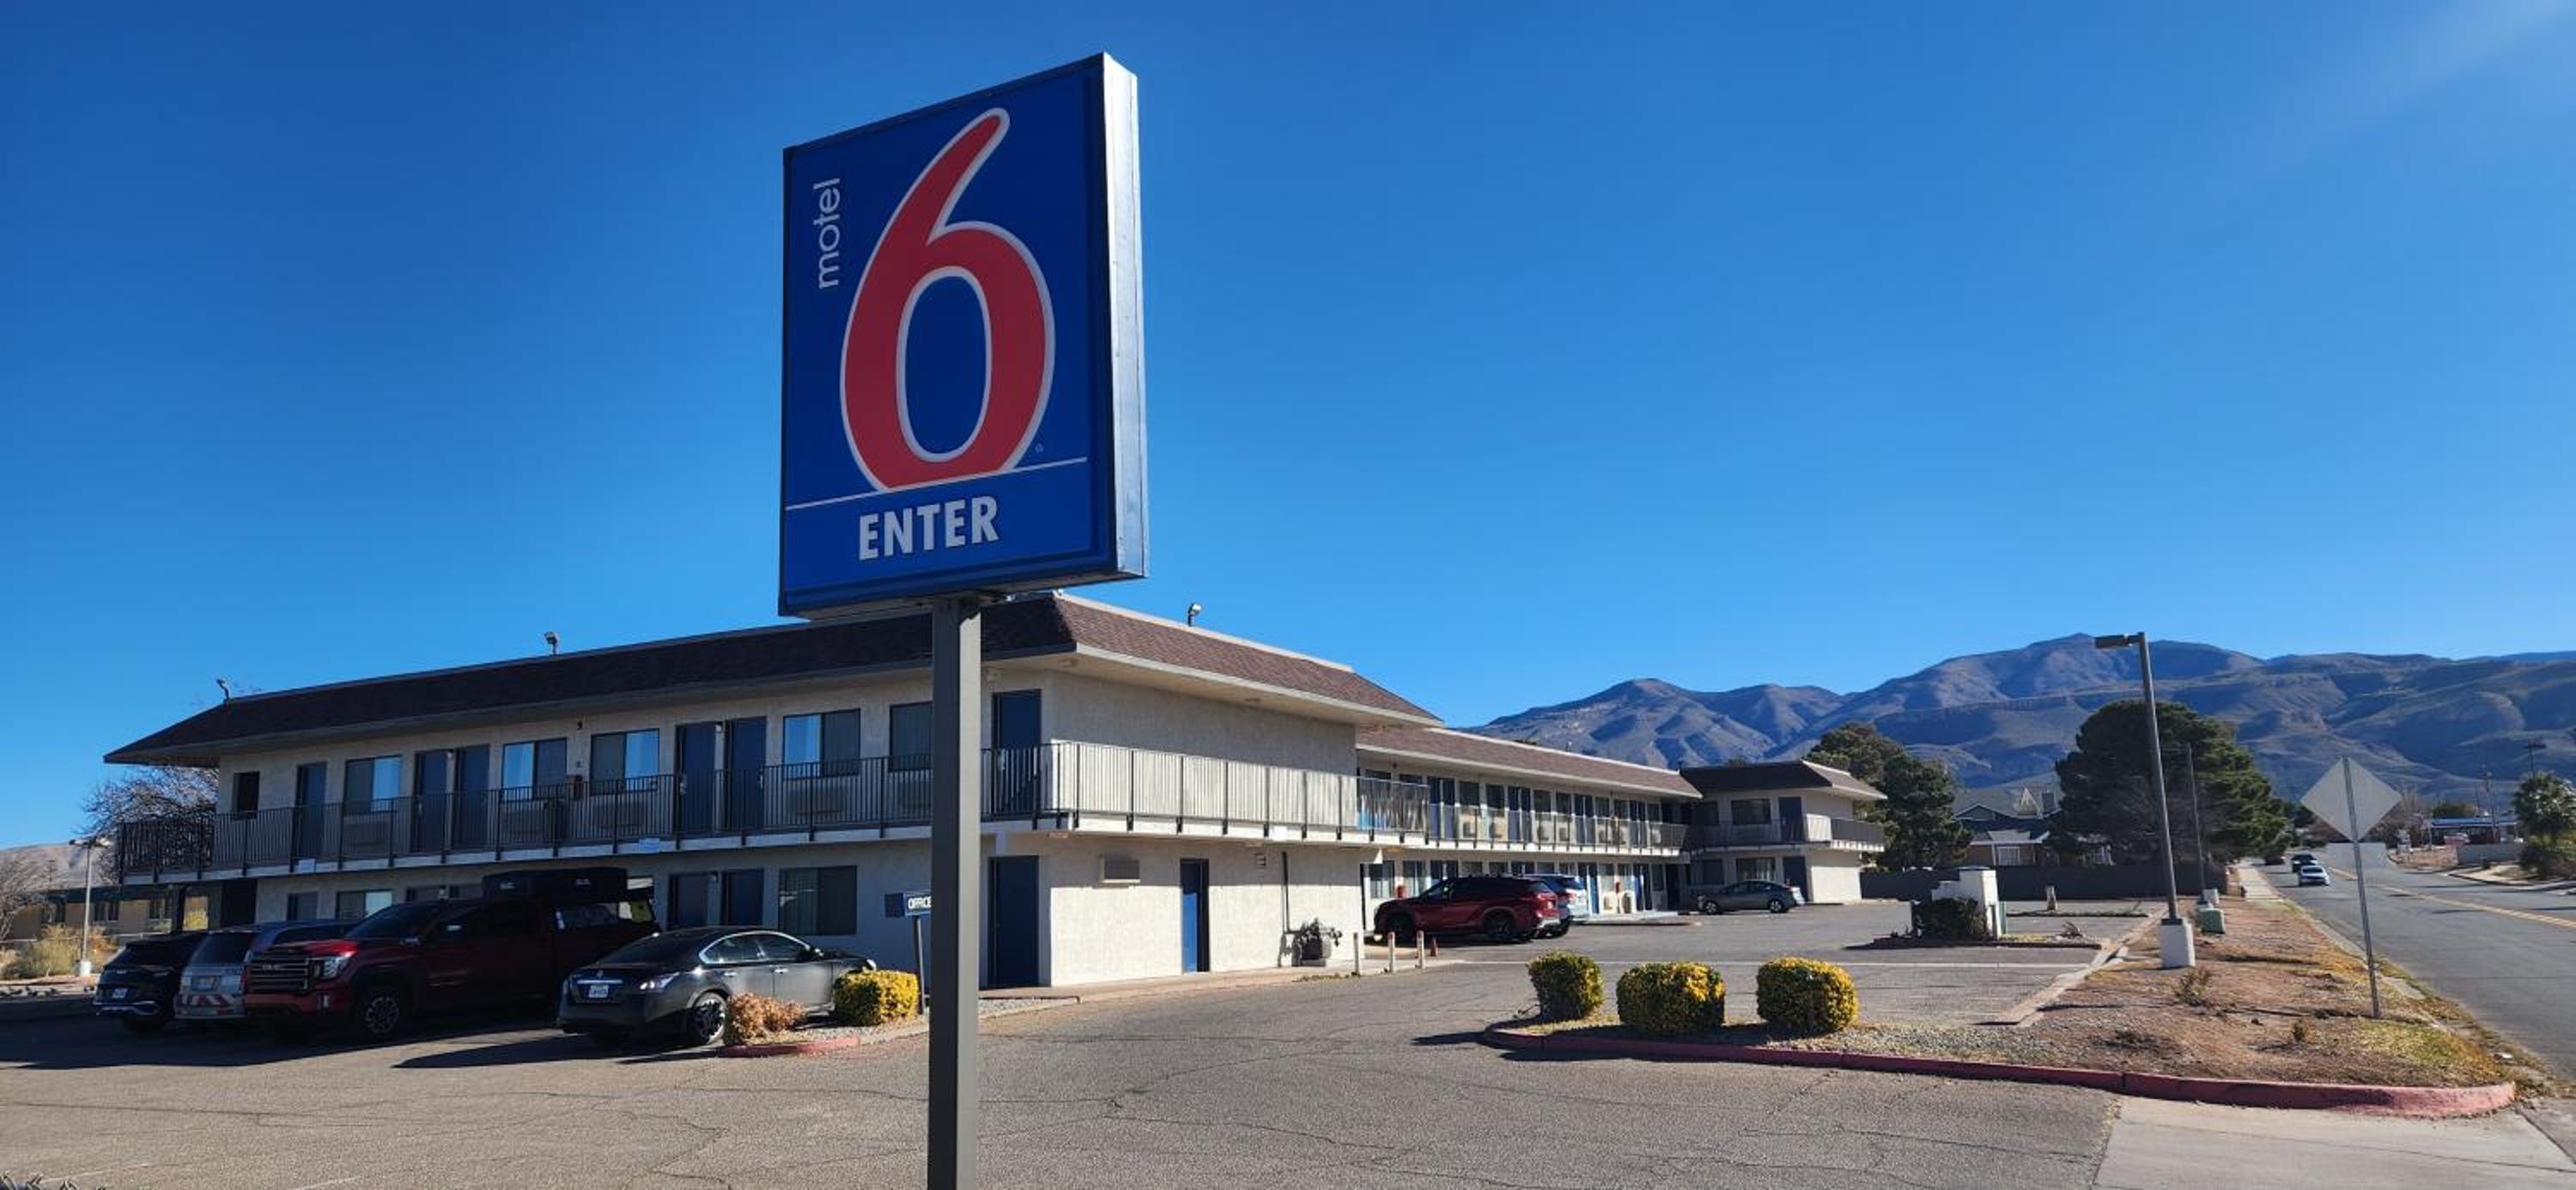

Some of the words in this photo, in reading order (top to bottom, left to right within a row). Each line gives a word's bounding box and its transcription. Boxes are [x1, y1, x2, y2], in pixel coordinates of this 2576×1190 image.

[812, 178, 841, 289] motel
[840, 108, 1055, 492] 6
[858, 495, 999, 561] ENTER
